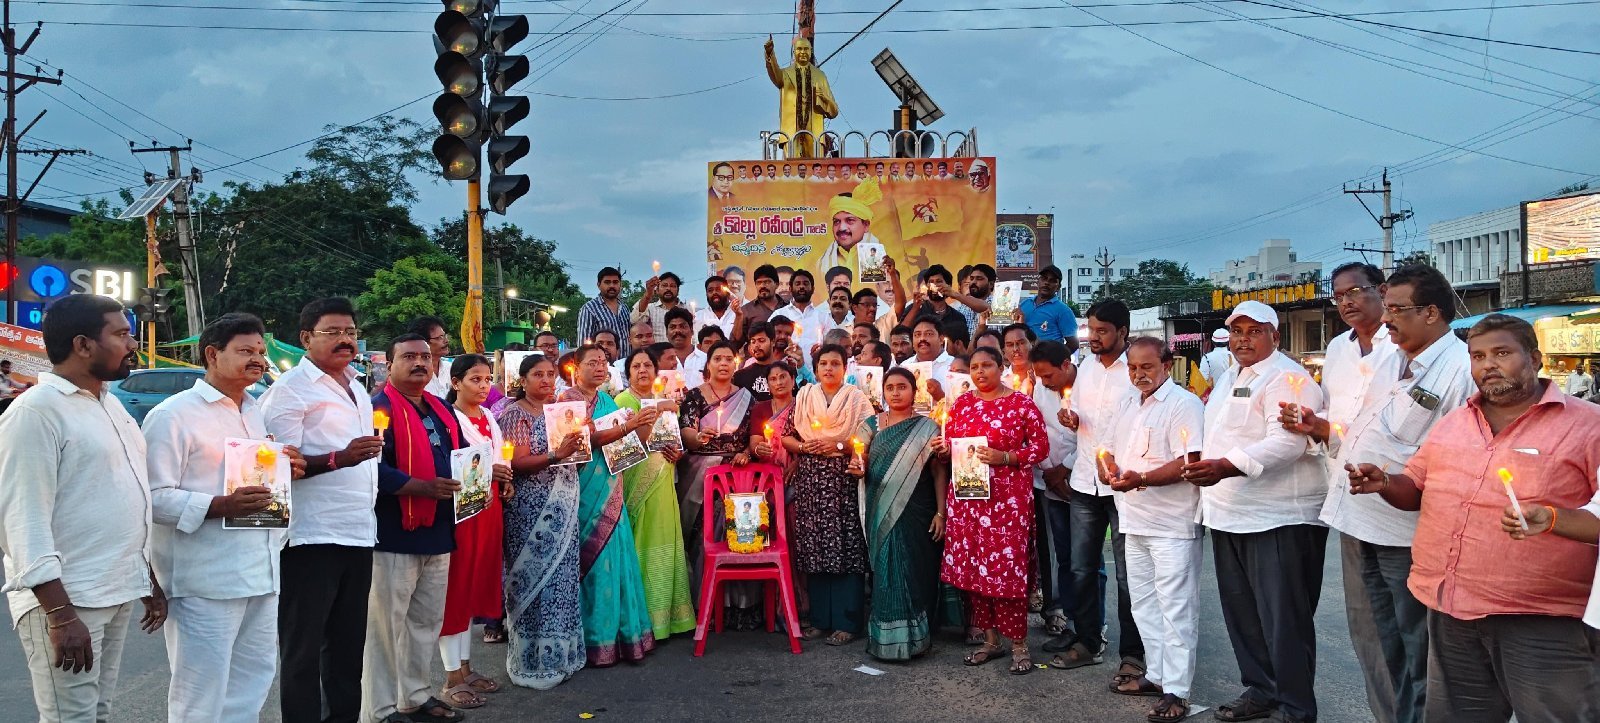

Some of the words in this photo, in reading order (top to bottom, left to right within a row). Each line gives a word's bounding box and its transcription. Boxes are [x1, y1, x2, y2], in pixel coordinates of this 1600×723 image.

[724, 215, 756, 239] కొల్లు
[760, 214, 804, 237] రవీంద్ర
[69, 267, 133, 301] SBI
